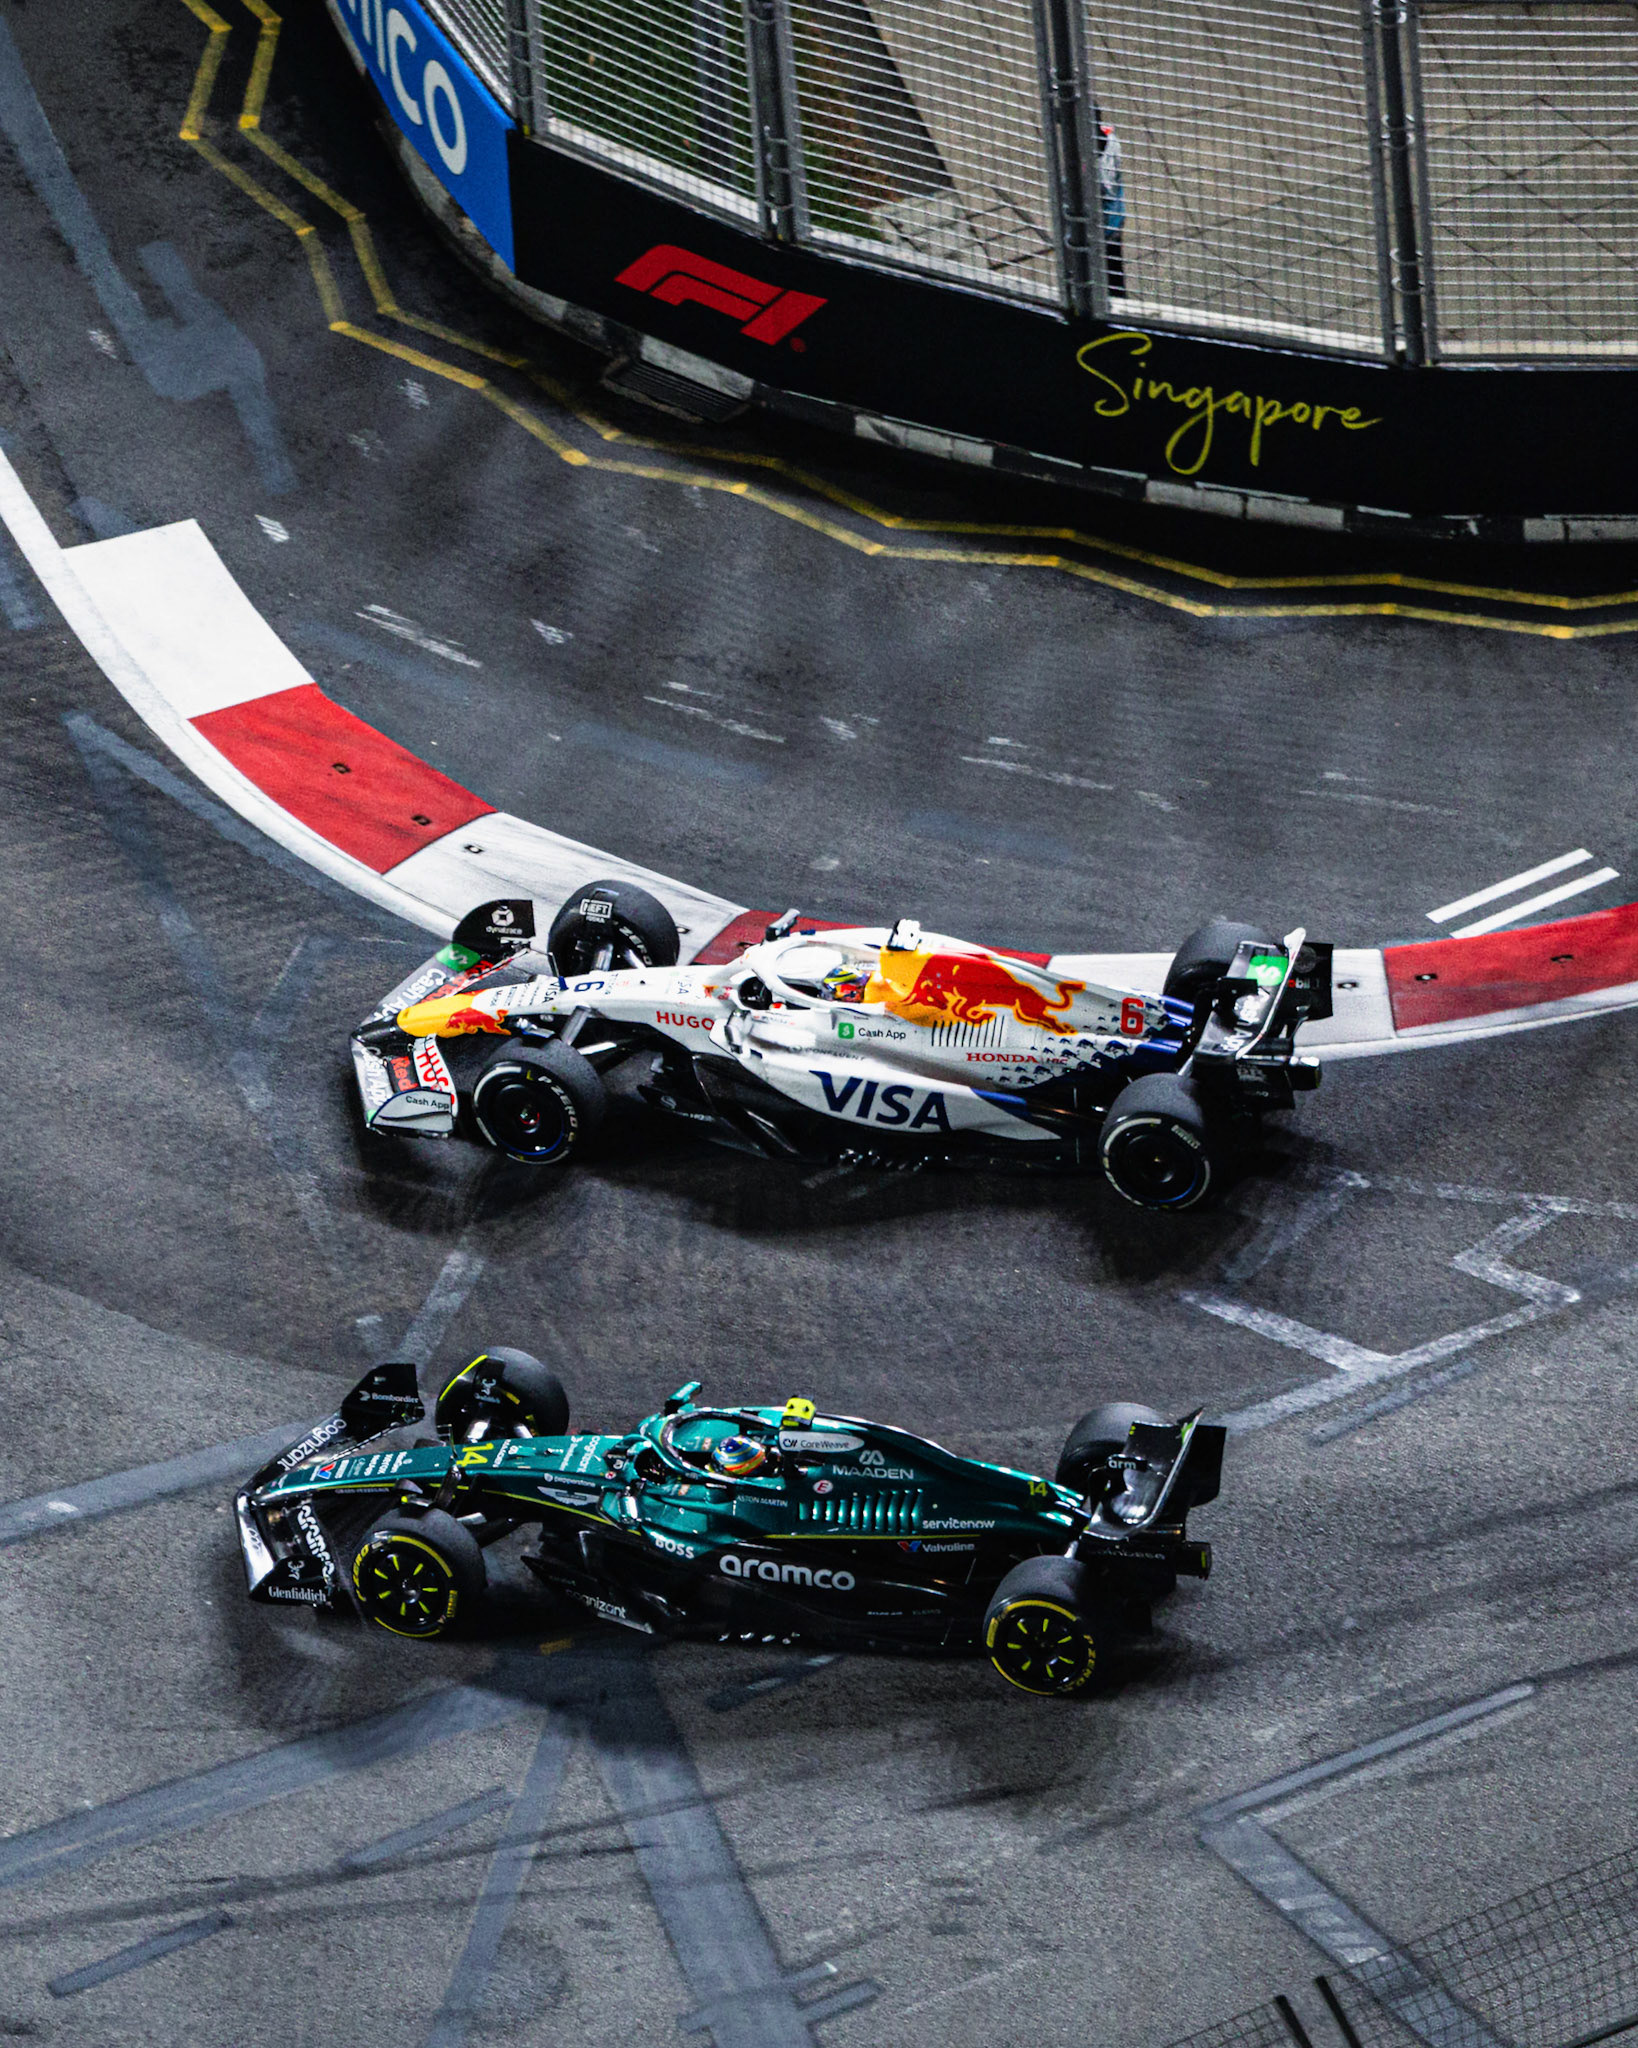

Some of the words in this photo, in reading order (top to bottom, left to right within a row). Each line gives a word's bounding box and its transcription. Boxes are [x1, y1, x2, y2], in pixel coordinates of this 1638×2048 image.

[614, 244, 828, 345] F1
[1075, 331, 1383, 475] Singapore
[402, 968, 447, 1001] Cash
[574, 981, 605, 992] 6
[1287, 978, 1311, 989] obil
[656, 1011, 715, 1031] HUGO
[1121, 997, 1144, 1035] 6
[858, 1028, 884, 1038] Cash
[885, 1030, 906, 1040] App
[966, 1052, 1040, 1064] HONDA
[405, 1095, 429, 1105] Cash
[430, 1100, 450, 1110] App
[809, 1069, 951, 1133] VISA
[277, 1418, 347, 1472] cognizant
[800, 1440, 850, 1449] CoreWeave
[456, 1443, 494, 1467] 14
[832, 1464, 915, 1480] MAADEN
[1108, 1460, 1137, 1470] arm
[1027, 1481, 1048, 1496] 14
[922, 1517, 995, 1530] servicenow
[653, 1532, 694, 1559] BOSS
[922, 1542, 976, 1553] Valvoline
[719, 1554, 856, 1591] aramco
[268, 1585, 328, 1602] Glenfiddich
